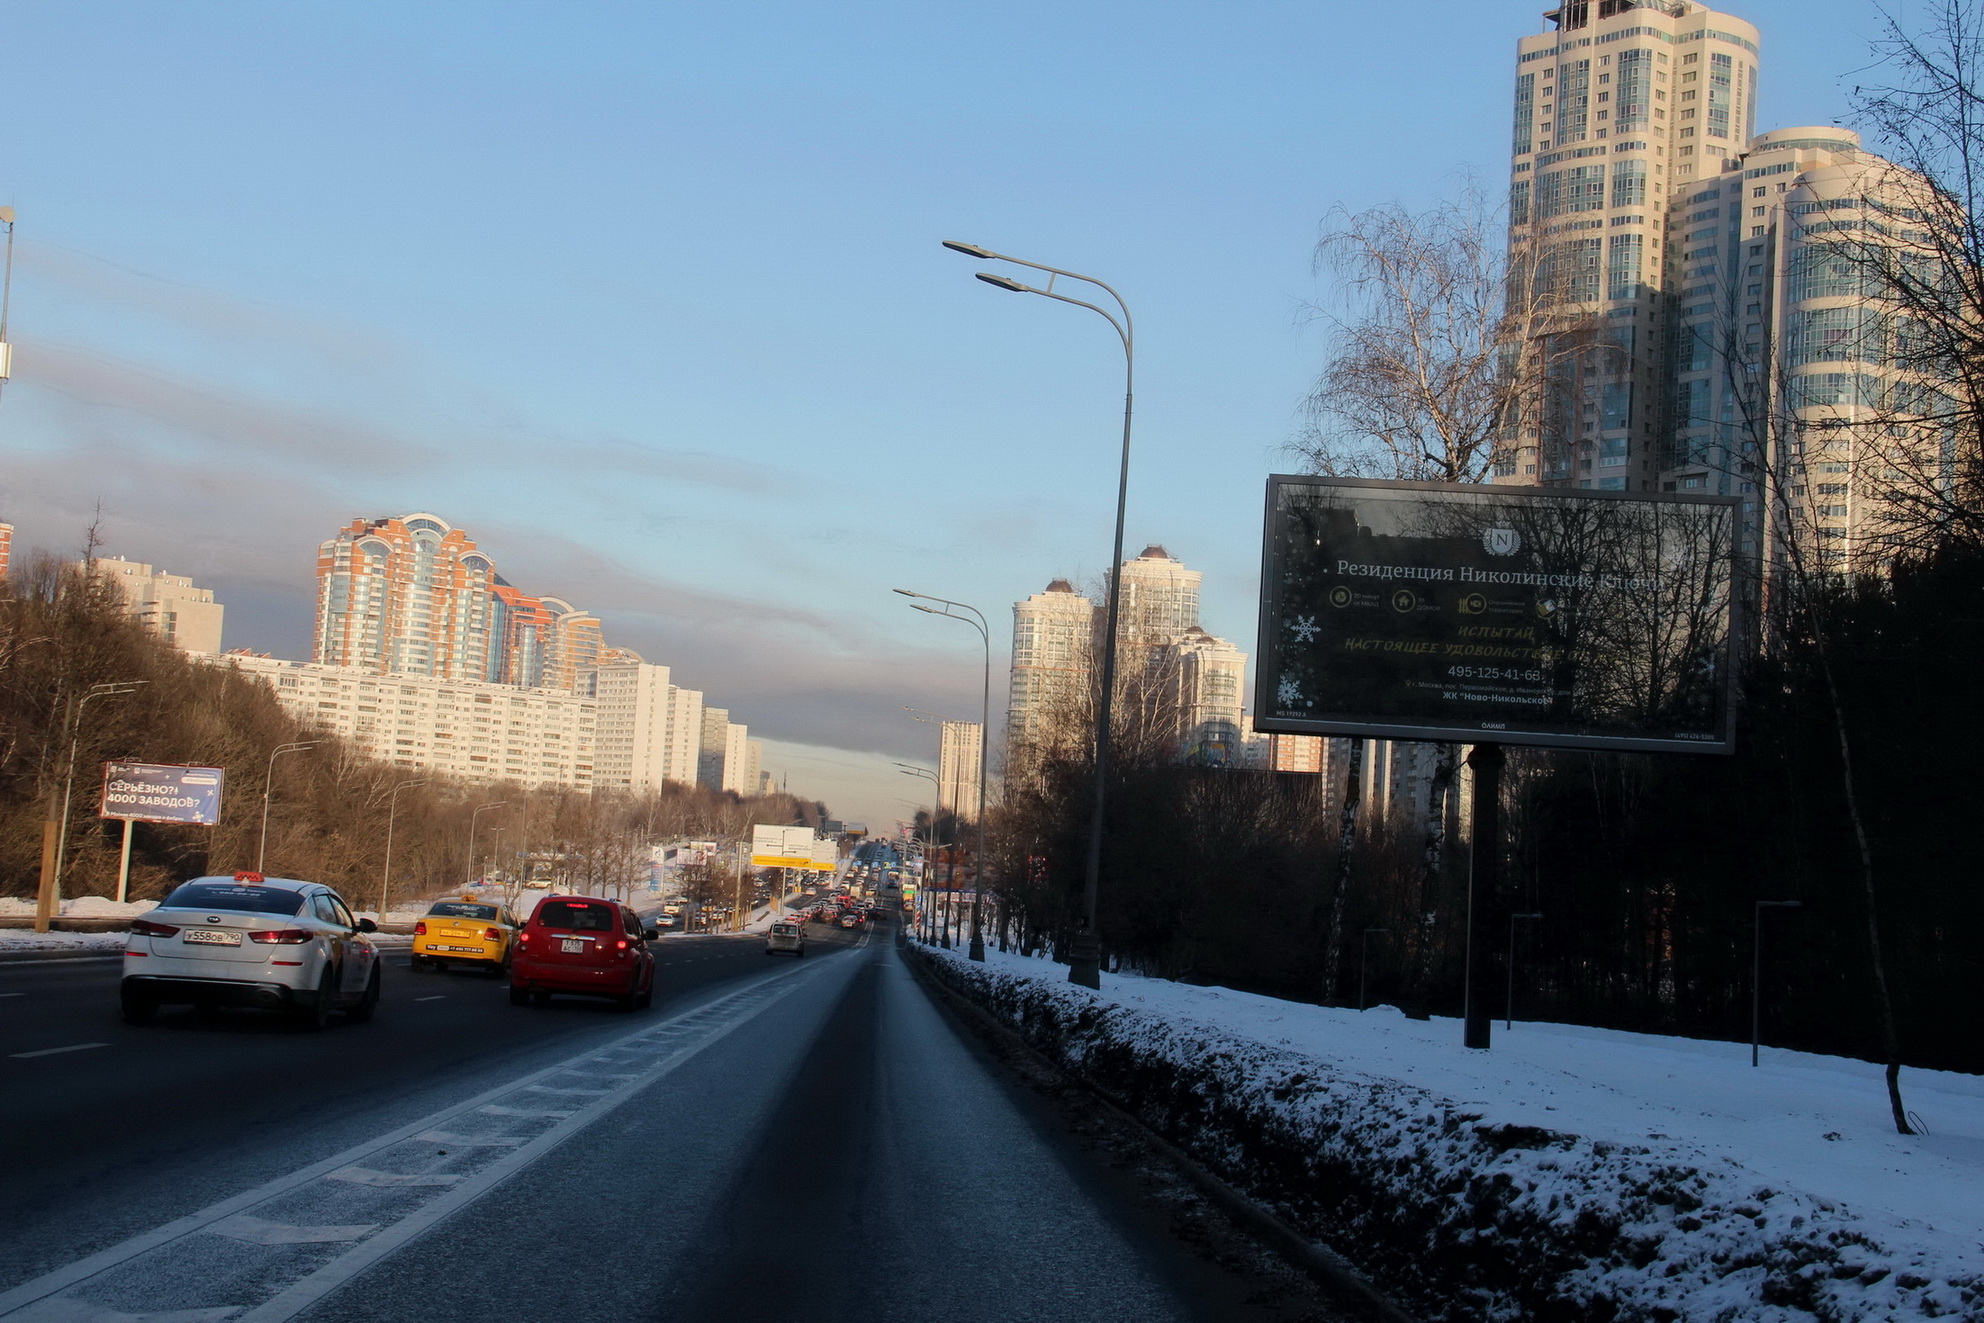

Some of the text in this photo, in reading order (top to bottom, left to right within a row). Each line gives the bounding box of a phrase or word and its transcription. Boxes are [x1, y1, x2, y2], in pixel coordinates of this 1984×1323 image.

[1496, 533, 1509, 546] N
[1336, 560, 1454, 582] Резиденция
[1459, 566, 1594, 589] Николинские
[1458, 625, 1535, 641] ИСПЫТАЙ
[1345, 638, 1440, 655] НАСТОЯЩЕЕ
[1444, 643, 1562, 660] УДОВОЛЬСТВИЕ
[1448, 665, 1542, 682] 495-125-41-63
[1442, 691, 1458, 701] ЖК
[107, 793, 200, 808] 4000 ЗАВОДОВ?
[225, 932, 240, 941] 790
